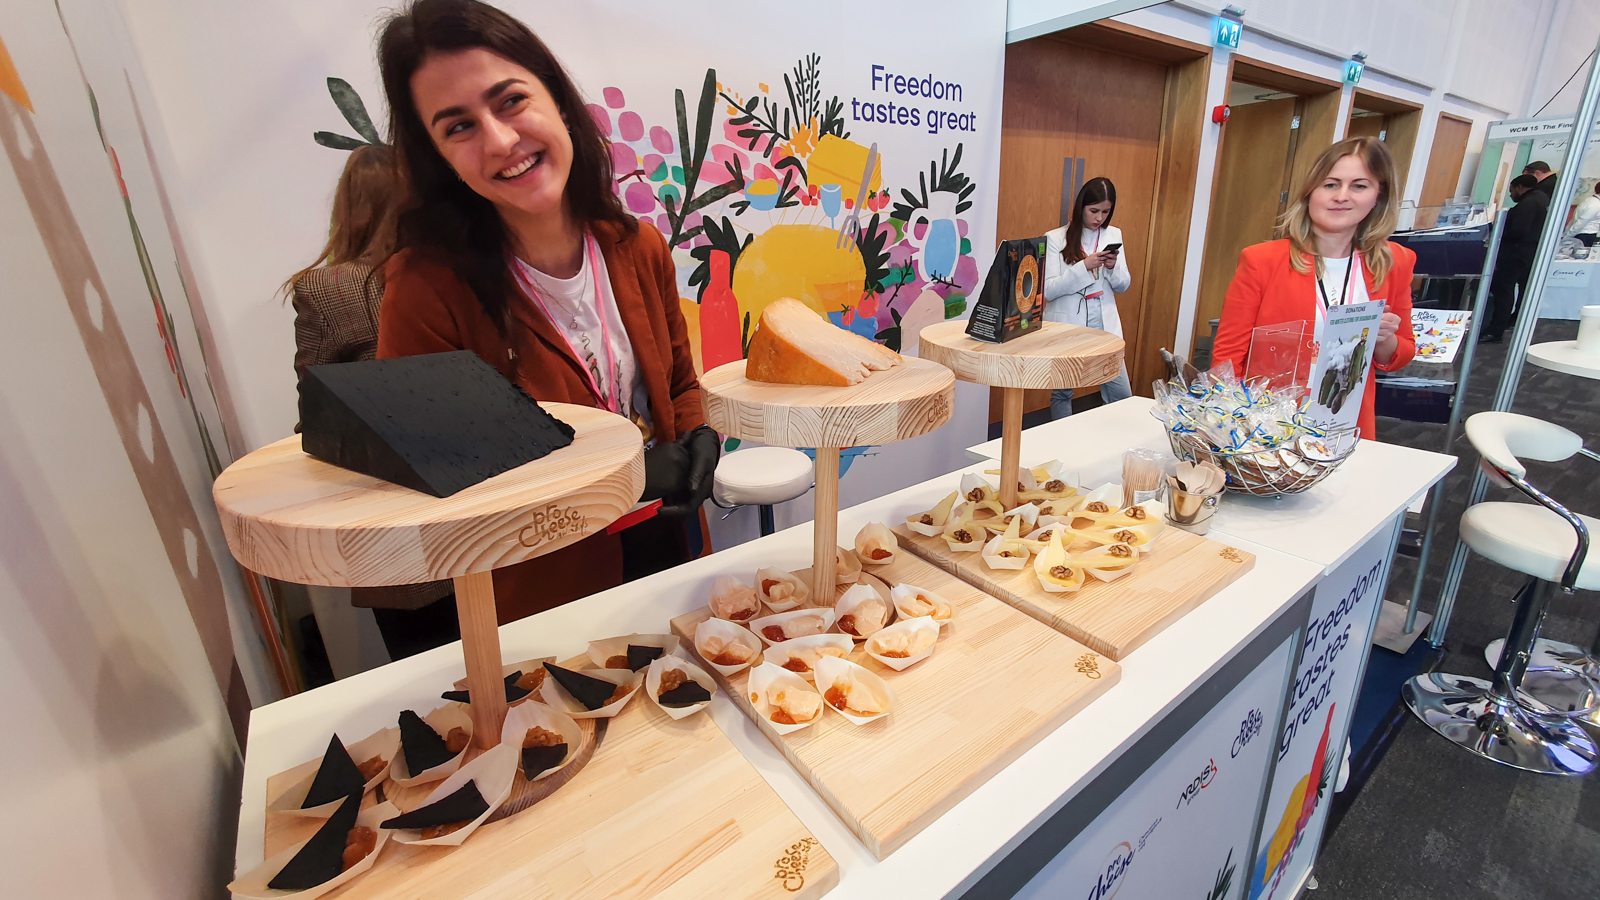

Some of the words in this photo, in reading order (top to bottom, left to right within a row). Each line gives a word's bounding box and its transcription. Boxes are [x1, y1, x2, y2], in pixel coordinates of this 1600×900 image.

[871, 64, 962, 102] Freedom
[852, 97, 920, 126] tastes
[927, 110, 976, 134] great
[1345, 306, 1366, 314] DONATIONS
[518, 506, 581, 548] Cheese
[533, 504, 561, 533] pro
[1300, 559, 1382, 665] Freedom
[1289, 623, 1351, 711] tastes
[1278, 670, 1335, 763] great
